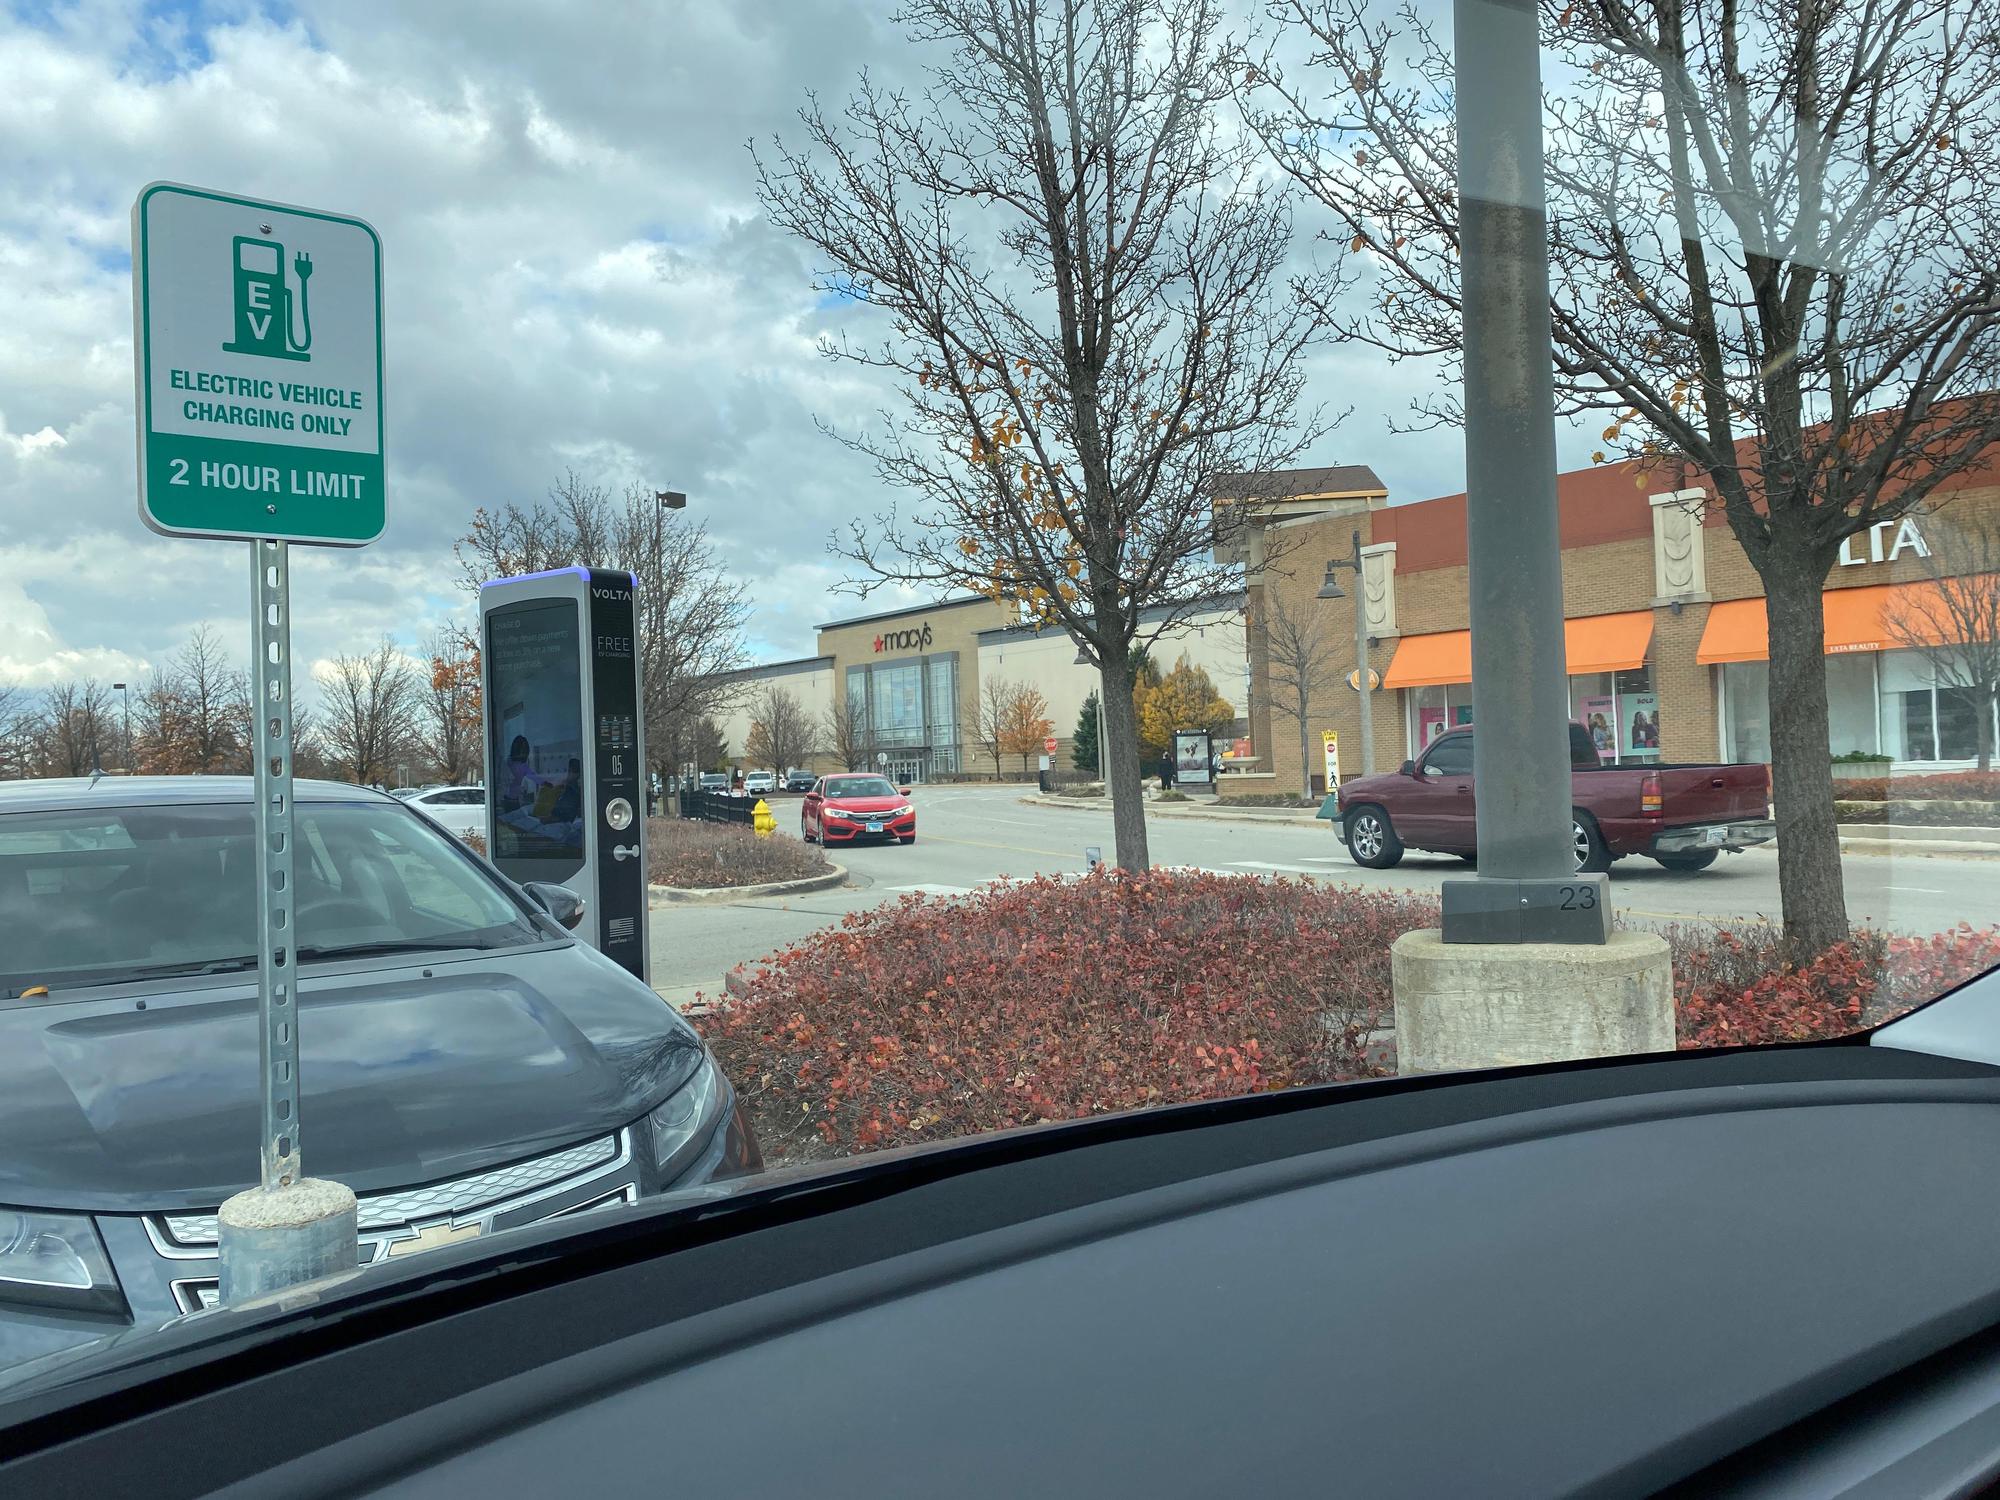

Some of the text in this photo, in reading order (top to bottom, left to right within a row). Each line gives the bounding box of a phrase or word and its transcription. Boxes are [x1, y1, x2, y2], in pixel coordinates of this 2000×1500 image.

[170, 369, 362, 410] ELECTRIC VEHICLE
[183, 401, 351, 436] CHARGING ONLY
[169, 459, 365, 500] 2 HOUR LIMIT
[1839, 518, 1932, 566] LTA
[592, 588, 631, 600] VOLTA
[597, 636, 631, 652] FREE
[884, 621, 932, 652] macy's
[1849, 642, 1880, 650] BEAUTY
[612, 754, 622, 775] 05
[1559, 885, 1596, 911] 23
